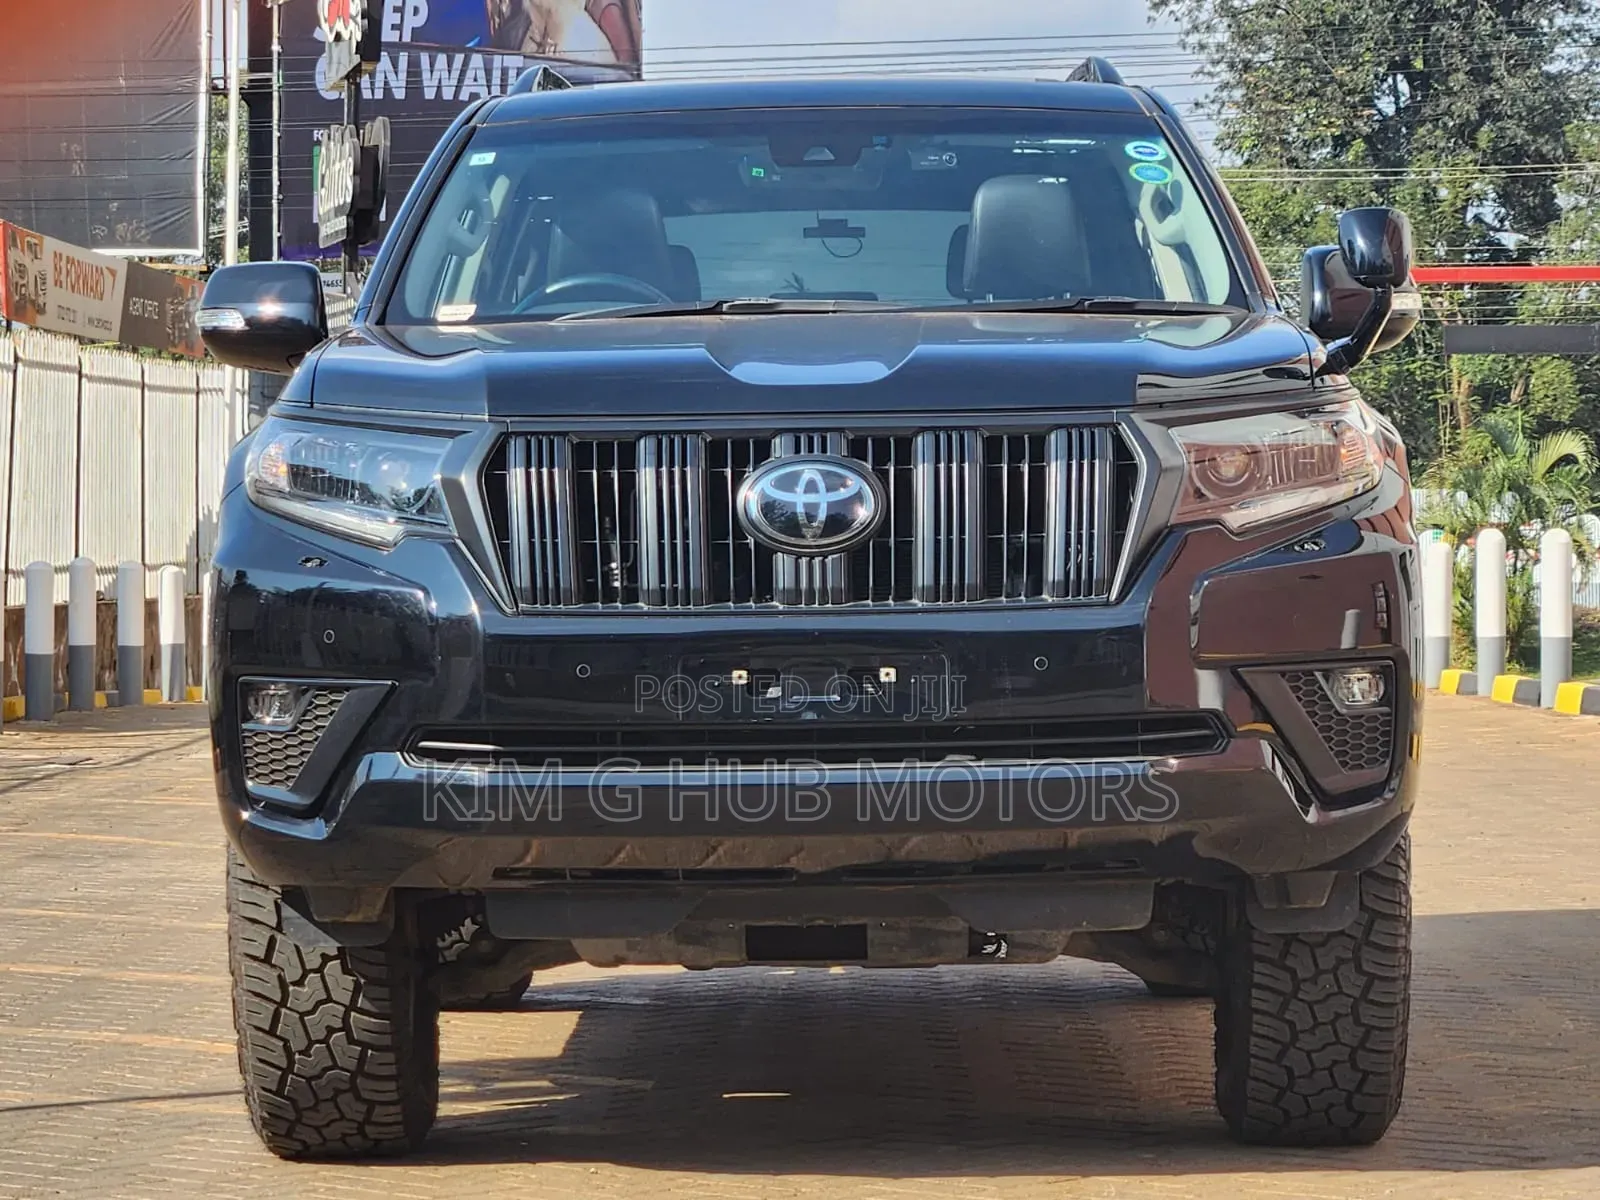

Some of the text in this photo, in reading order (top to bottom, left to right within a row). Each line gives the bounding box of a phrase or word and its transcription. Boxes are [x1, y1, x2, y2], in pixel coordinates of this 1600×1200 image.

[420, 52, 524, 100] WAIT
[53, 250, 105, 301] BE FORWARD
